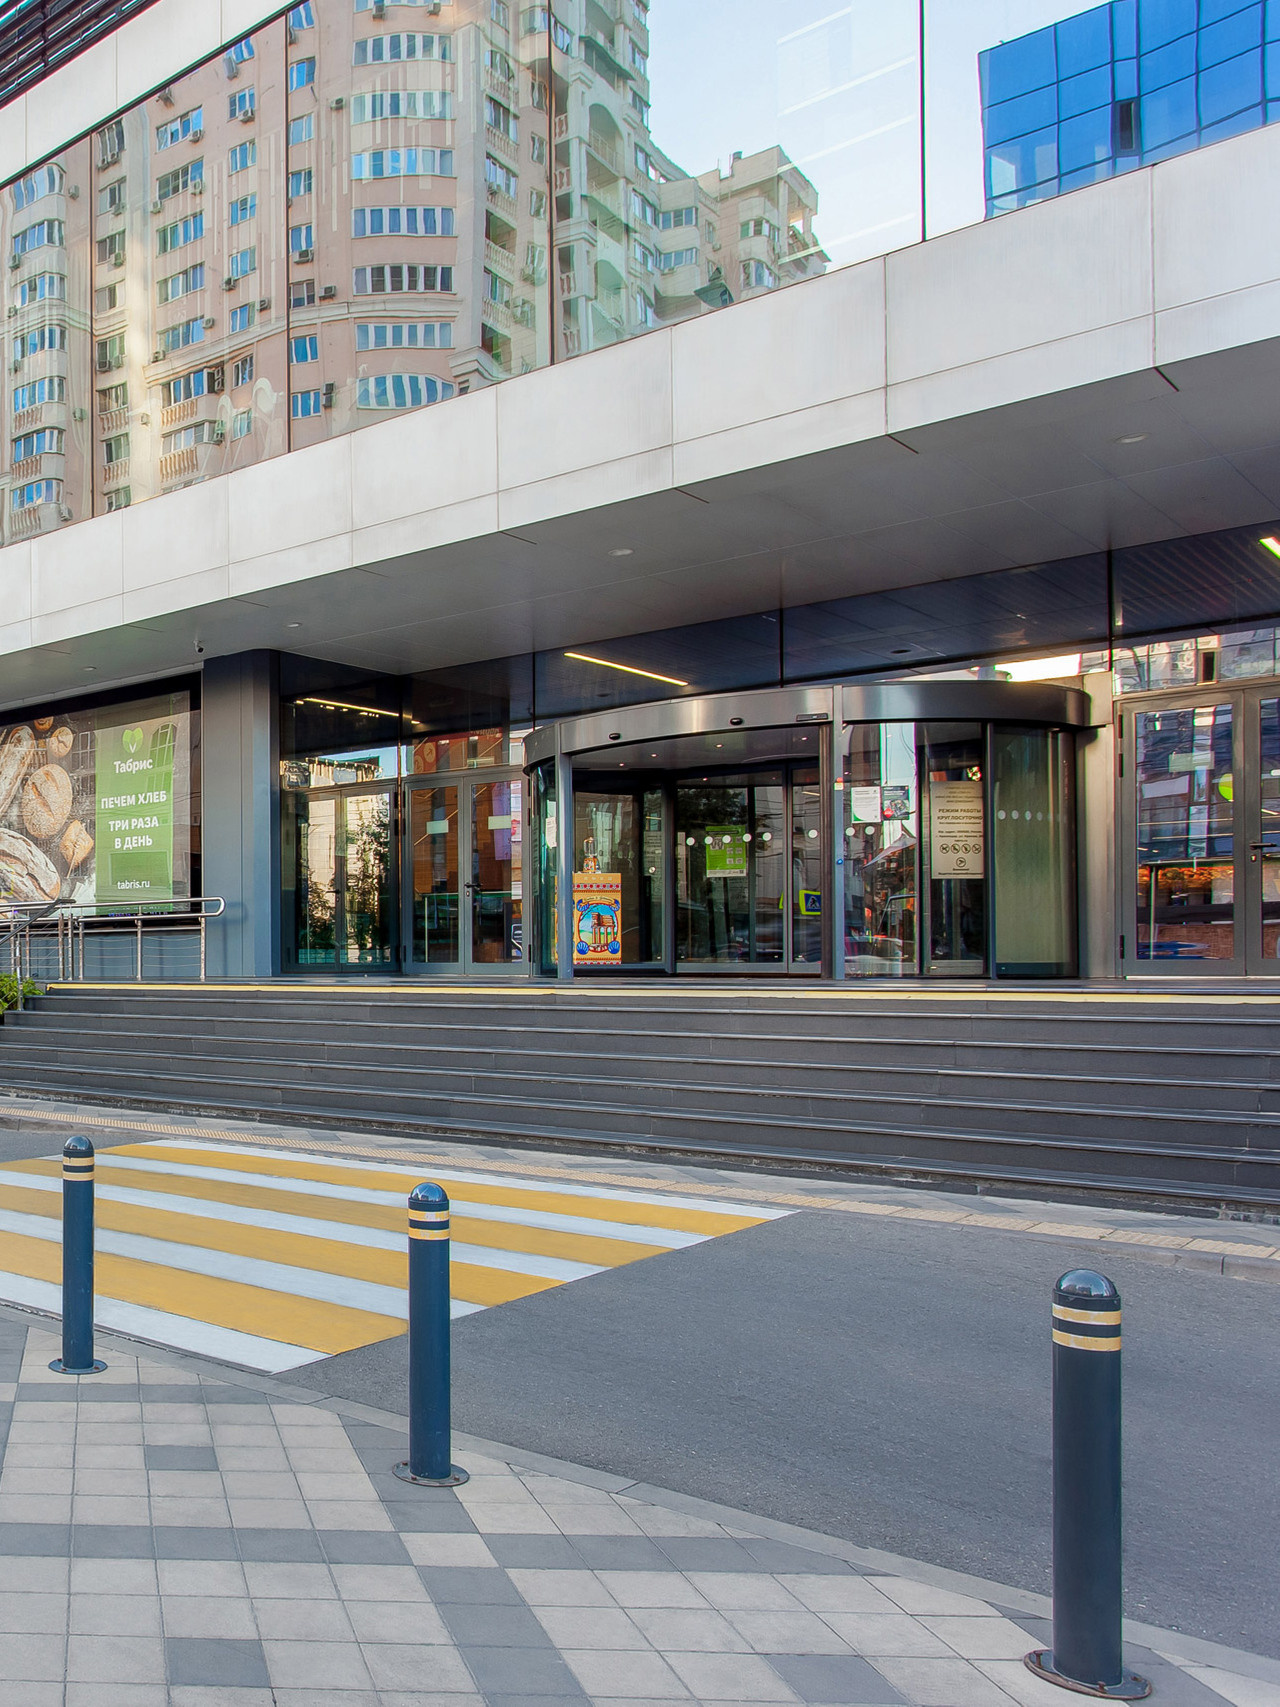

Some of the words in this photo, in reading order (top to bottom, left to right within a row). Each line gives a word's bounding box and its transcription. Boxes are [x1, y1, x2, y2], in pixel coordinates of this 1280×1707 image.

[114, 758, 153, 774] Табрис
[101, 794, 136, 809] ПЕЧЕМ
[138, 791, 167, 805] ХЛЕБ
[108, 819, 130, 832] ТРИ
[131, 816, 159, 829] РАЗА
[114, 838, 122, 849] В
[123, 835, 153, 850] ДЕНЬ
[117, 879, 150, 890] tabris.ru
